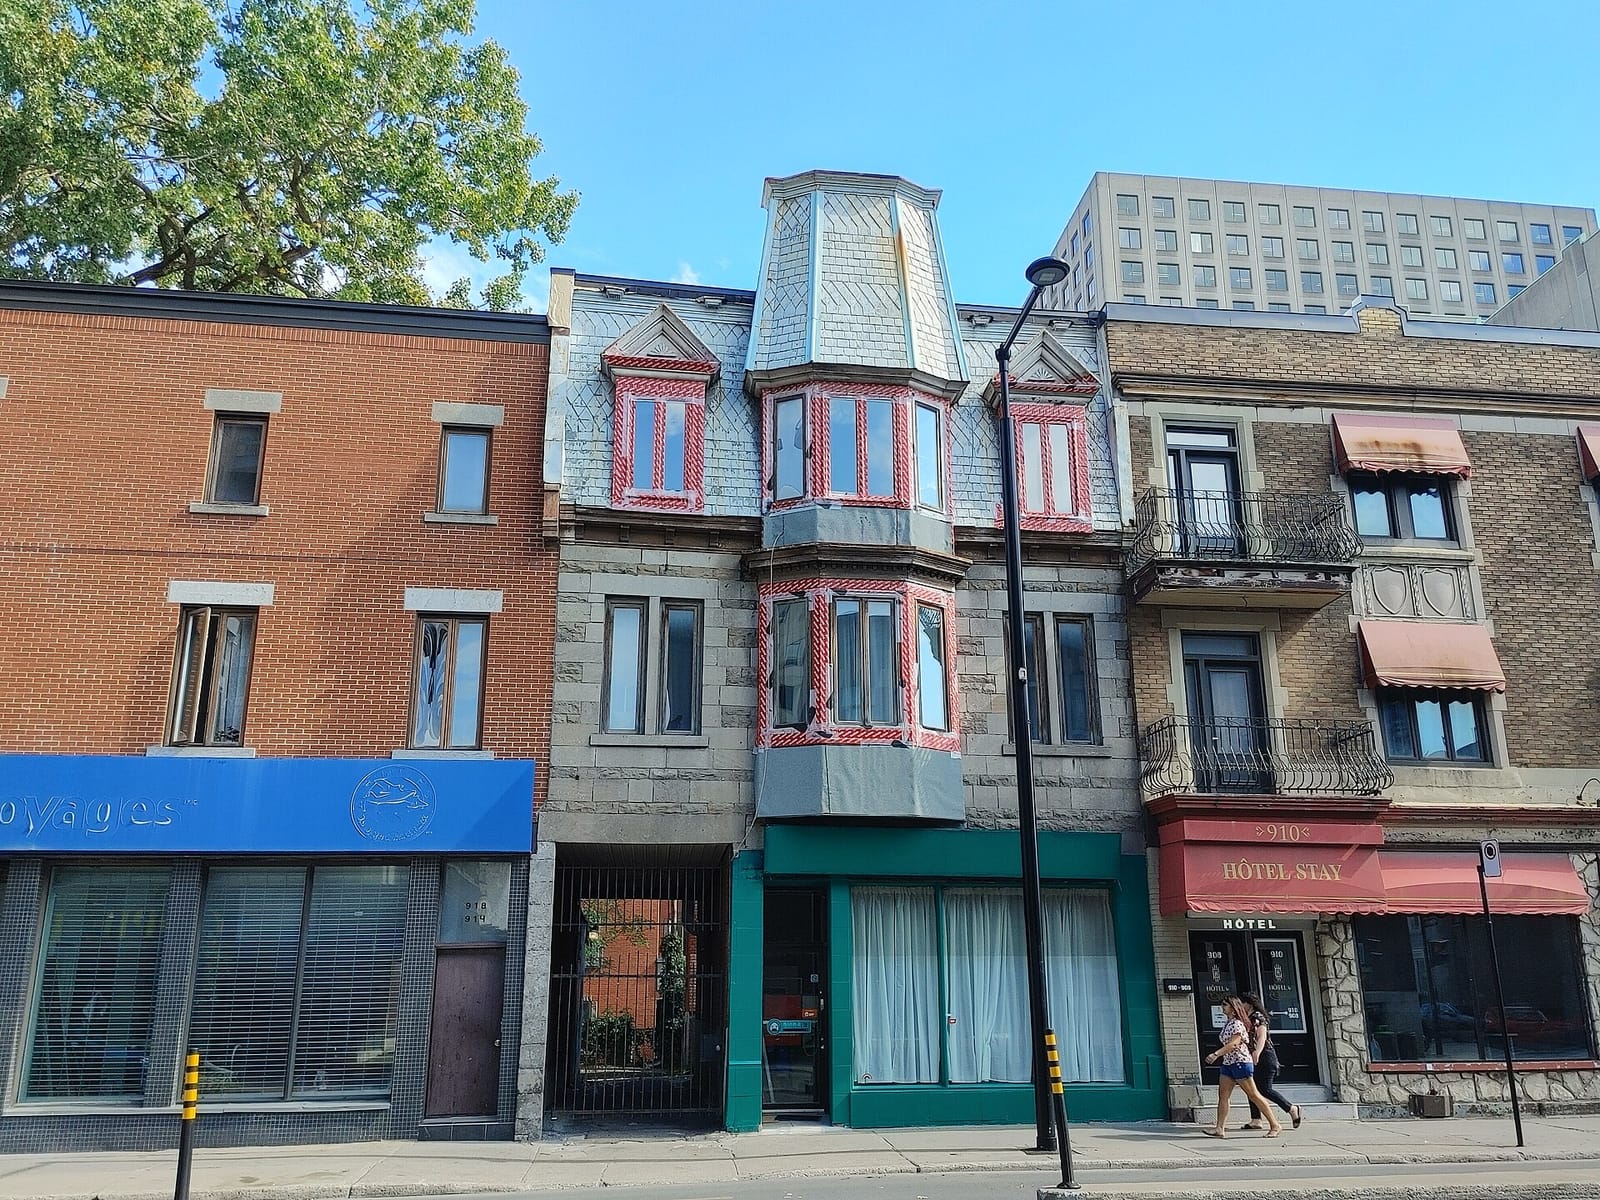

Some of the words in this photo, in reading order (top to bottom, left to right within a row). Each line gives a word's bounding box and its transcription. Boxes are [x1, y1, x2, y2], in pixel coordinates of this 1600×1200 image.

[1267, 824, 1300, 842] 910
[1222, 858, 1291, 881] HÔTEL
[1295, 863, 1342, 881] STAY
[465, 902, 487, 910] 918
[464, 915, 486, 923] 914
[1223, 918, 1277, 929] HÔTEL
